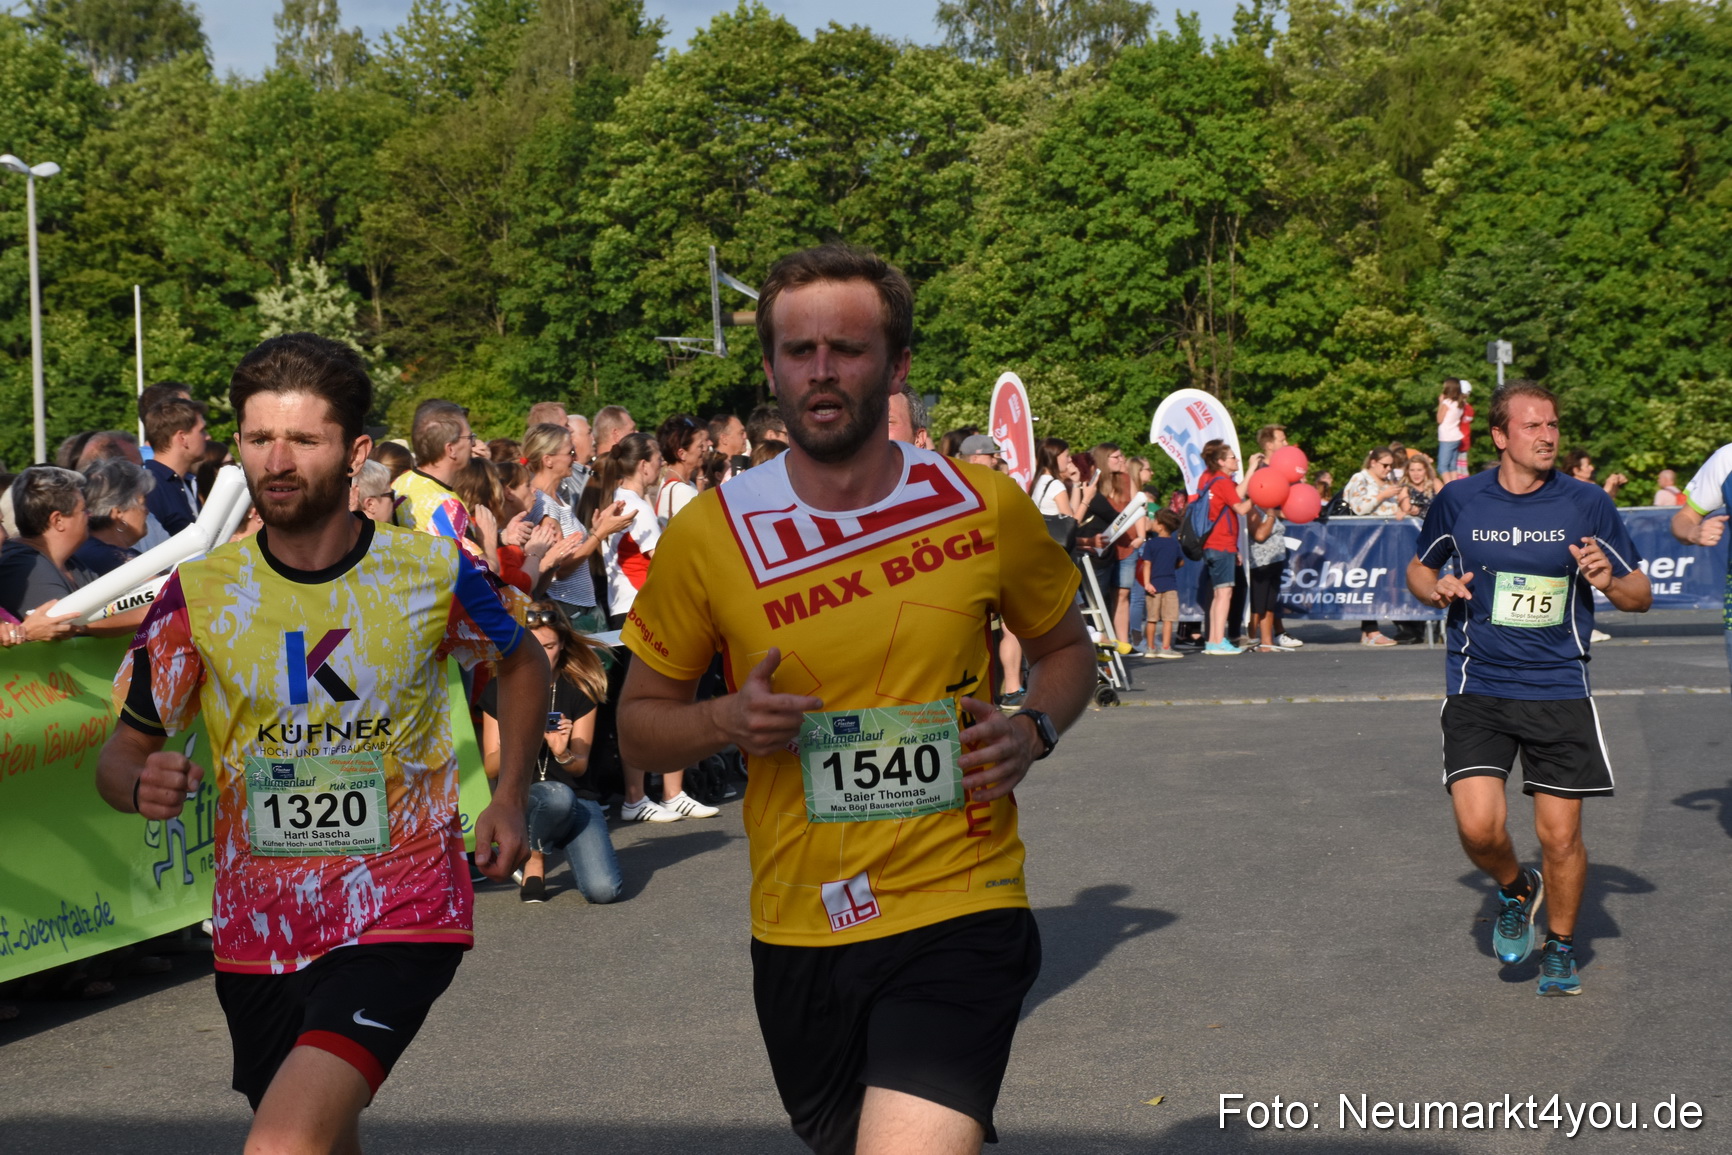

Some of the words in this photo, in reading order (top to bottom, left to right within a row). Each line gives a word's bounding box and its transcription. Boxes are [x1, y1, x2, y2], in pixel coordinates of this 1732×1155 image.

[1472, 529, 1510, 542] EURO
[1524, 529, 1565, 542] POLES
[763, 569, 872, 630] MAX
[880, 528, 995, 587] BÖGL
[1276, 592, 1374, 604] TOMOBILE
[1511, 593, 1552, 613] 715
[4, 671, 84, 714] Firmen
[258, 717, 392, 744] KÜFNER
[823, 729, 885, 744] firmenlauf
[899, 736, 918, 745] run
[922, 731, 949, 744] 2019
[260, 746, 292, 757] HOCH-
[295, 747, 319, 758] UND
[323, 744, 360, 757] TIEFBAU
[363, 741, 393, 752] GMBH
[823, 744, 940, 791] 1540
[264, 776, 316, 787] firmenlauf
[350, 779, 376, 790] 2019
[844, 791, 875, 803] Baier
[878, 788, 926, 800] Thomas
[264, 791, 367, 829] 1320
[830, 803, 847, 811] Max
[849, 802, 868, 812] Bögl
[869, 800, 914, 810] Bauservice
[916, 795, 941, 805] GmbH
[284, 830, 309, 840] Hartl
[311, 829, 350, 839] Sascha
[262, 839, 285, 847] Küfner
[324, 839, 350, 847] Tiefbau
[352, 838, 375, 846] GmbH
